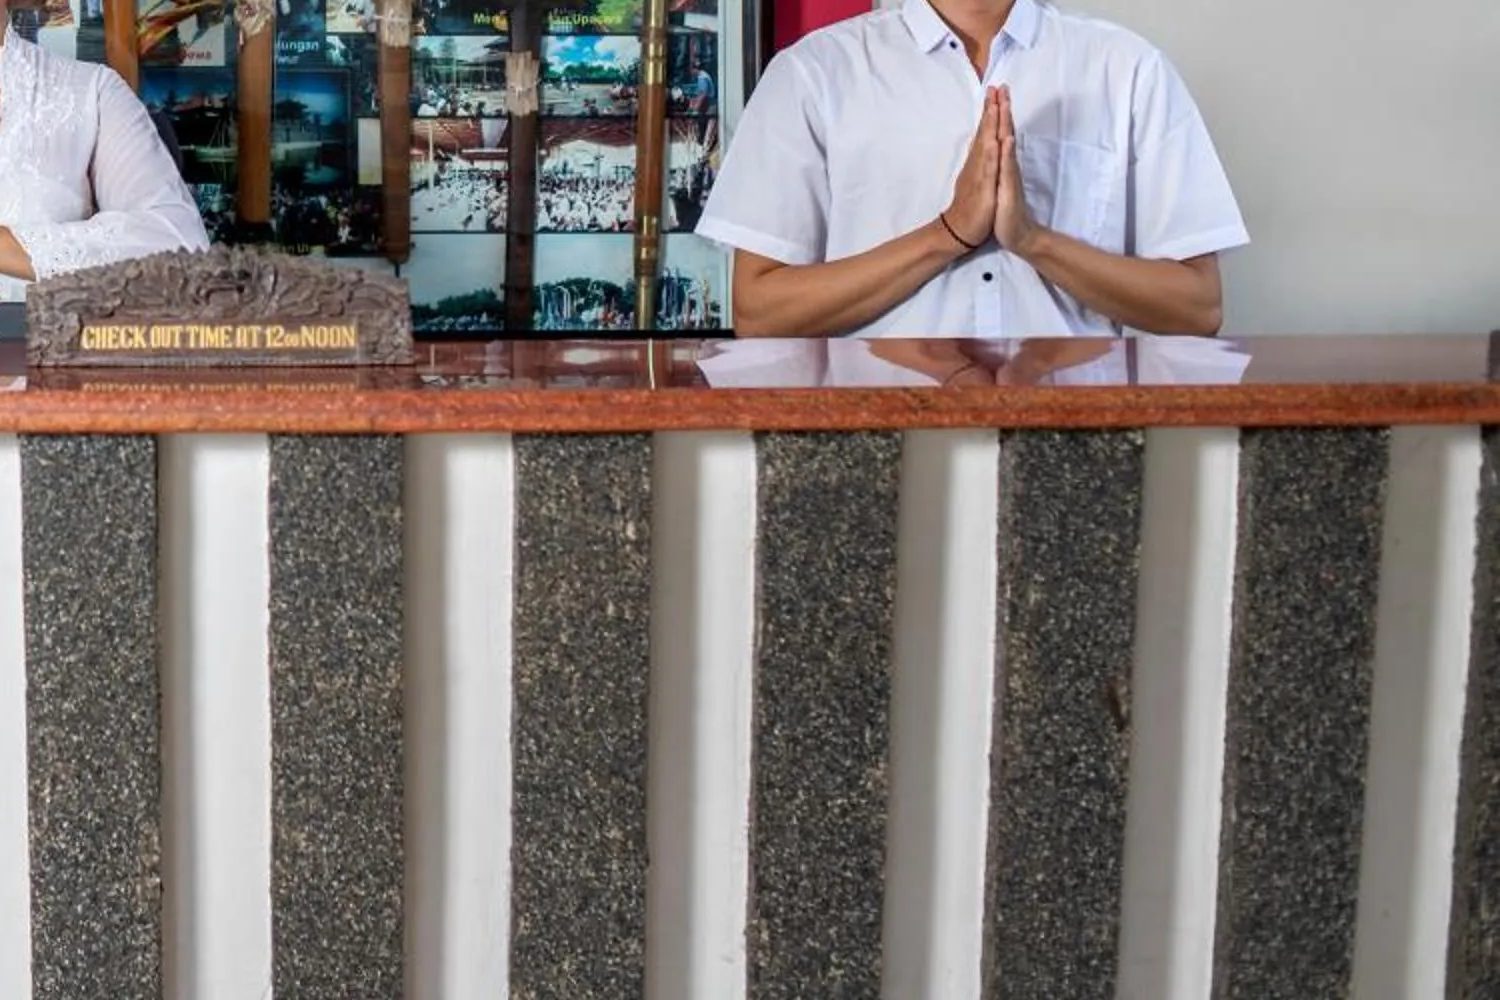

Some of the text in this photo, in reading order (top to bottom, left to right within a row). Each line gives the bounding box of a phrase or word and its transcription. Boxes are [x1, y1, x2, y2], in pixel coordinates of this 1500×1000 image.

[82, 325, 148, 350] CHECK
[150, 325, 182, 349] OUT
[183, 325, 233, 349] TIME
[236, 325, 263, 349] AT
[300, 325, 357, 349] NOON
